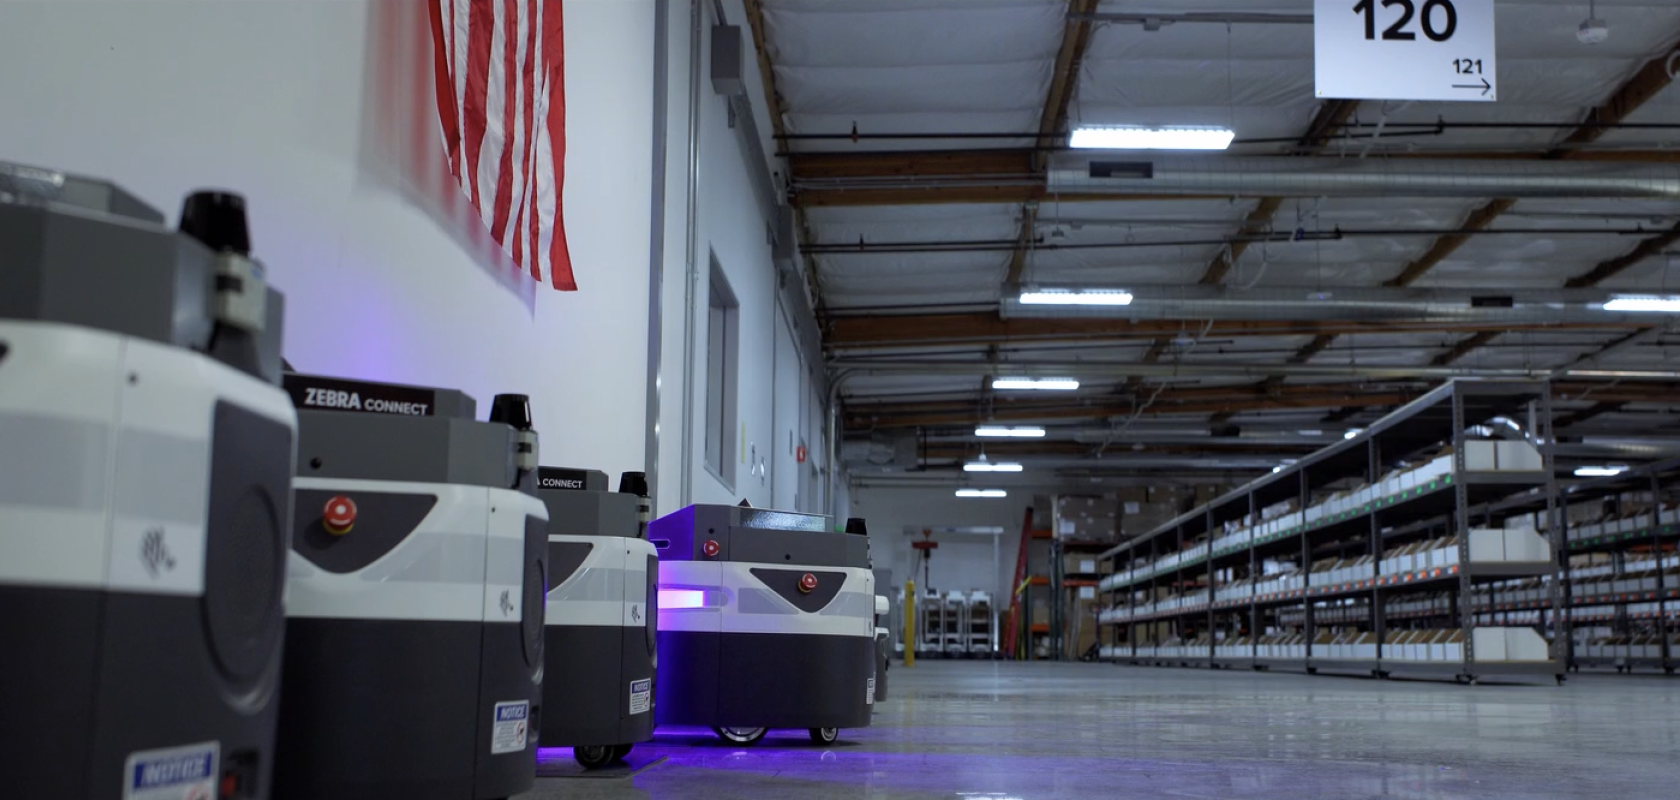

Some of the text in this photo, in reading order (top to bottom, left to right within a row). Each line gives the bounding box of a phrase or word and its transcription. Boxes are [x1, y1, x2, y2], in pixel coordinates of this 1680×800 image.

[1352, 0, 1458, 42] 120
[1452, 58, 1483, 75] 121
[304, 387, 429, 416] ZEBRA CONNECT
[542, 477, 584, 489] CONNECT
[633, 682, 649, 692] NOTICE
[500, 704, 526, 719] NOTICE
